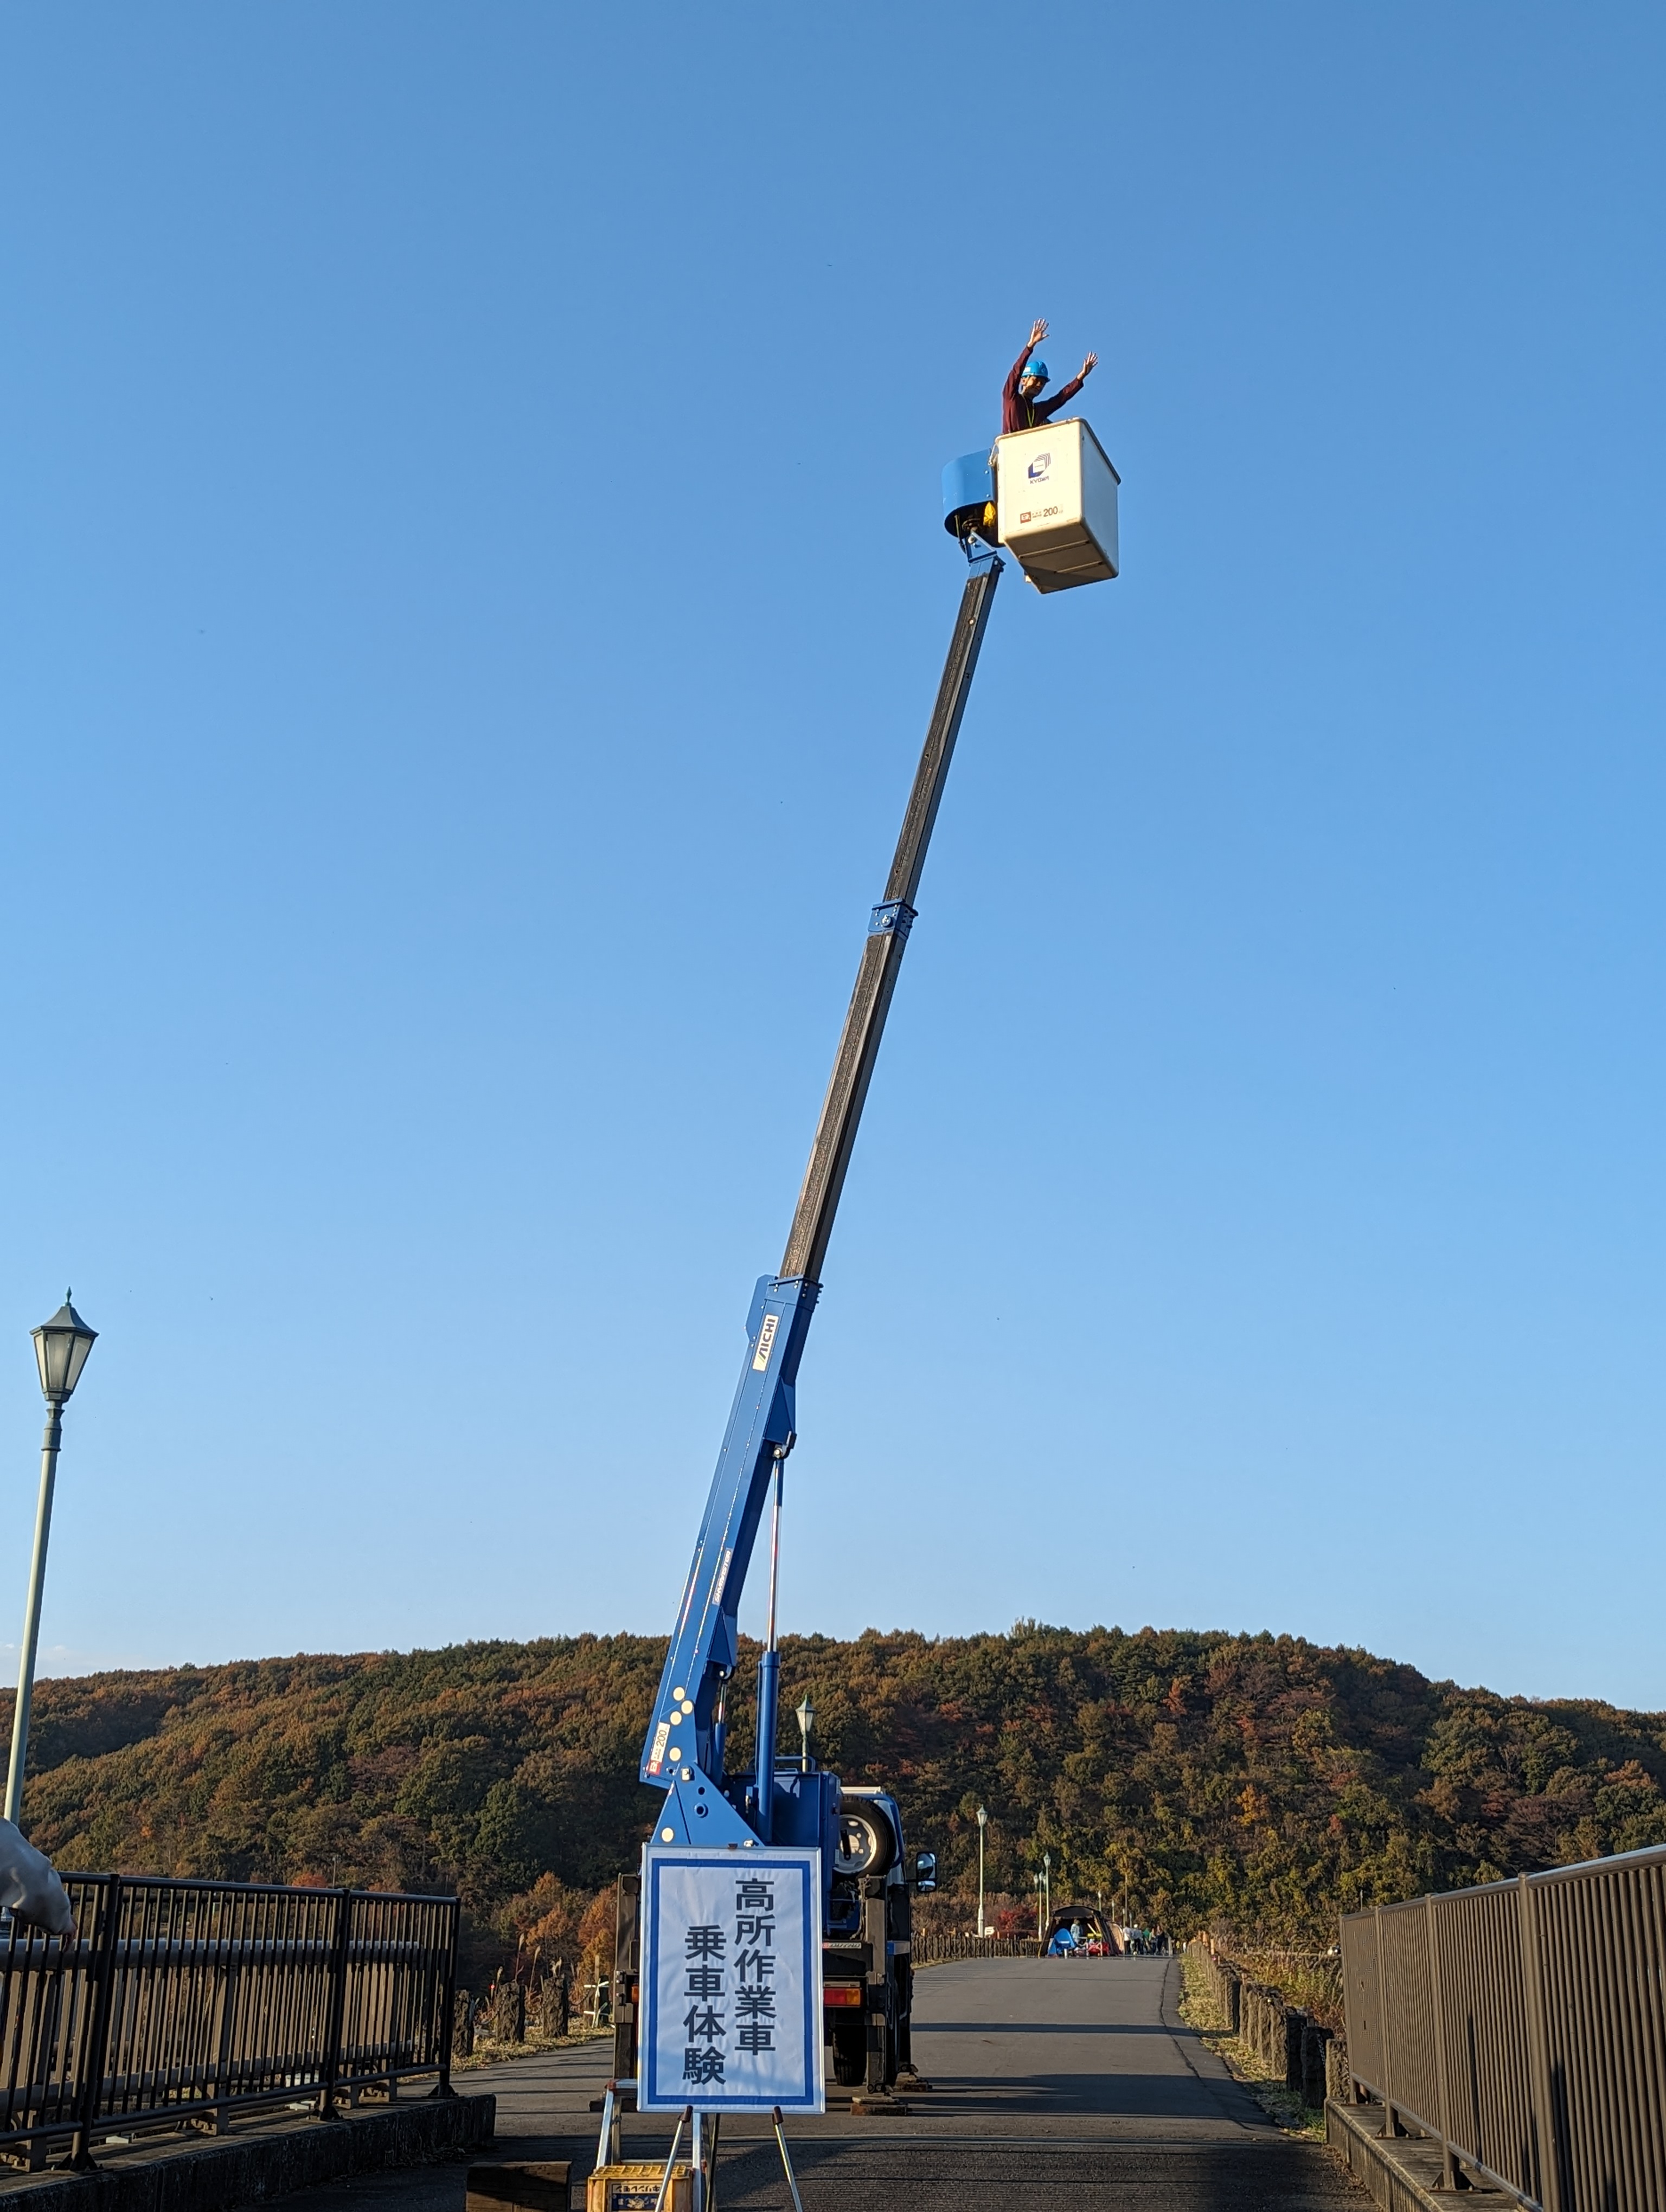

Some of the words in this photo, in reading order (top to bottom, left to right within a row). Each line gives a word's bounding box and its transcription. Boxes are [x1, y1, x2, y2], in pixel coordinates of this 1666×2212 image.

[1043, 505, 1058, 517] 200
[759, 1318, 776, 1363] AICHI
[656, 1729, 667, 1747] 200
[734, 1877, 777, 2056] 高所作業車
[682, 1924, 727, 2085] 乗車体験
